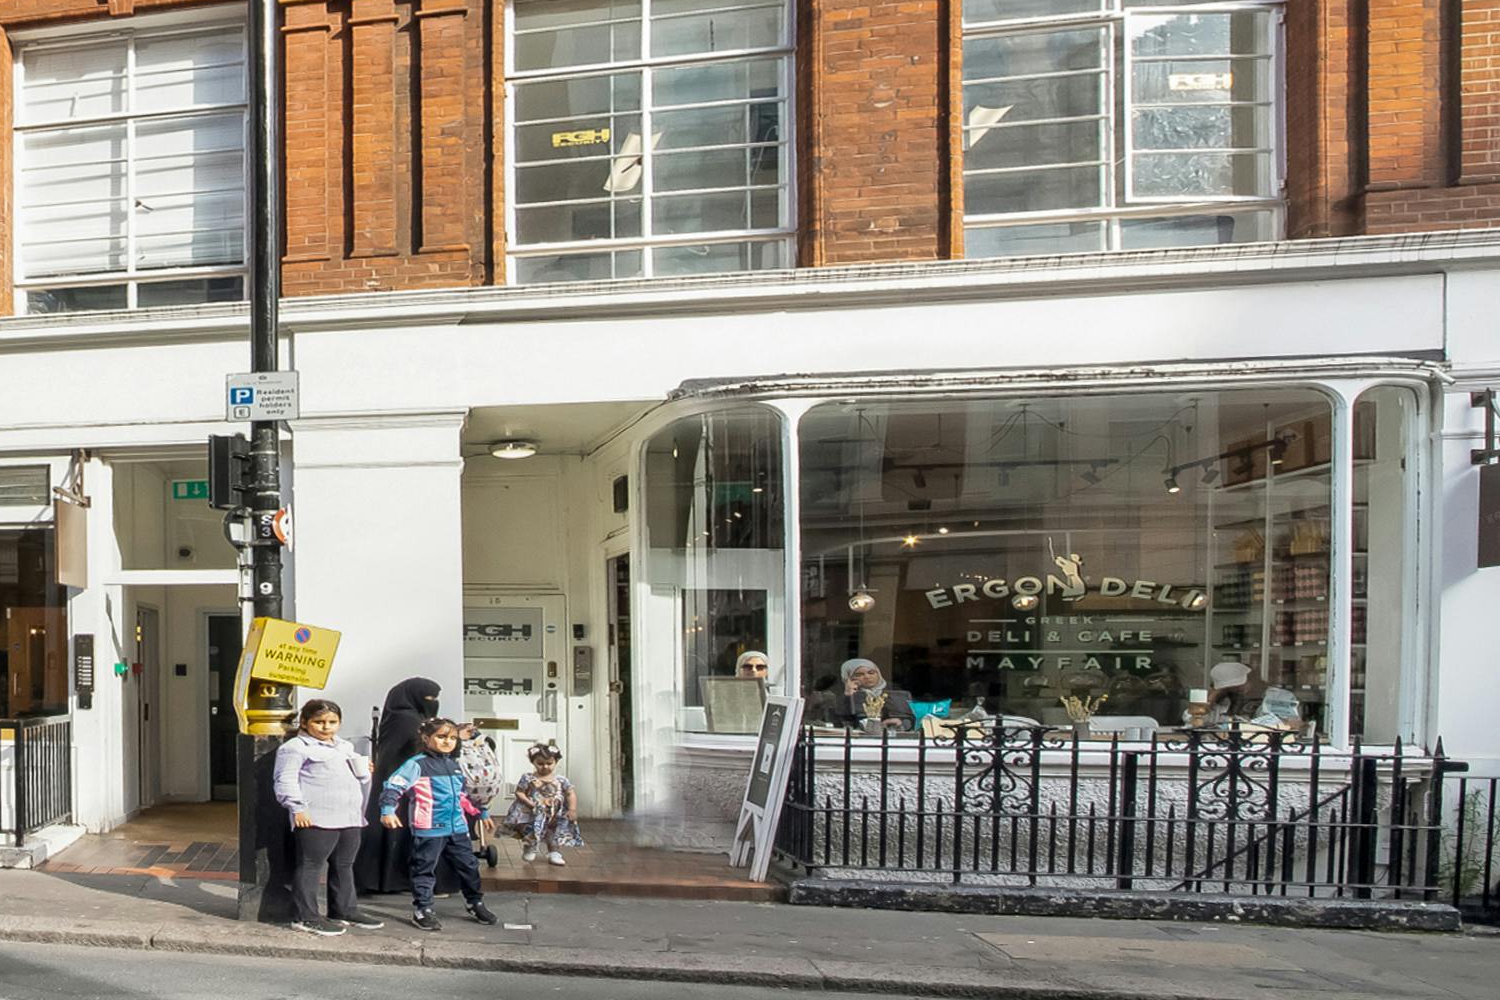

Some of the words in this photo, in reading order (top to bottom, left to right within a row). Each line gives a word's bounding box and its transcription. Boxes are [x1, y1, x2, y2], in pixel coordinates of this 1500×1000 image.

[236, 390, 250, 403] P
[925, 574, 1086, 609] ERGON
[1025, 616, 1094, 625] GREEK
[967, 631, 1031, 642] DELI
[1047, 631, 1062, 642] &
[1077, 630, 1153, 643] CAFE
[265, 648, 326, 668] WARNING
[966, 656, 1152, 670] MAYFAIR
